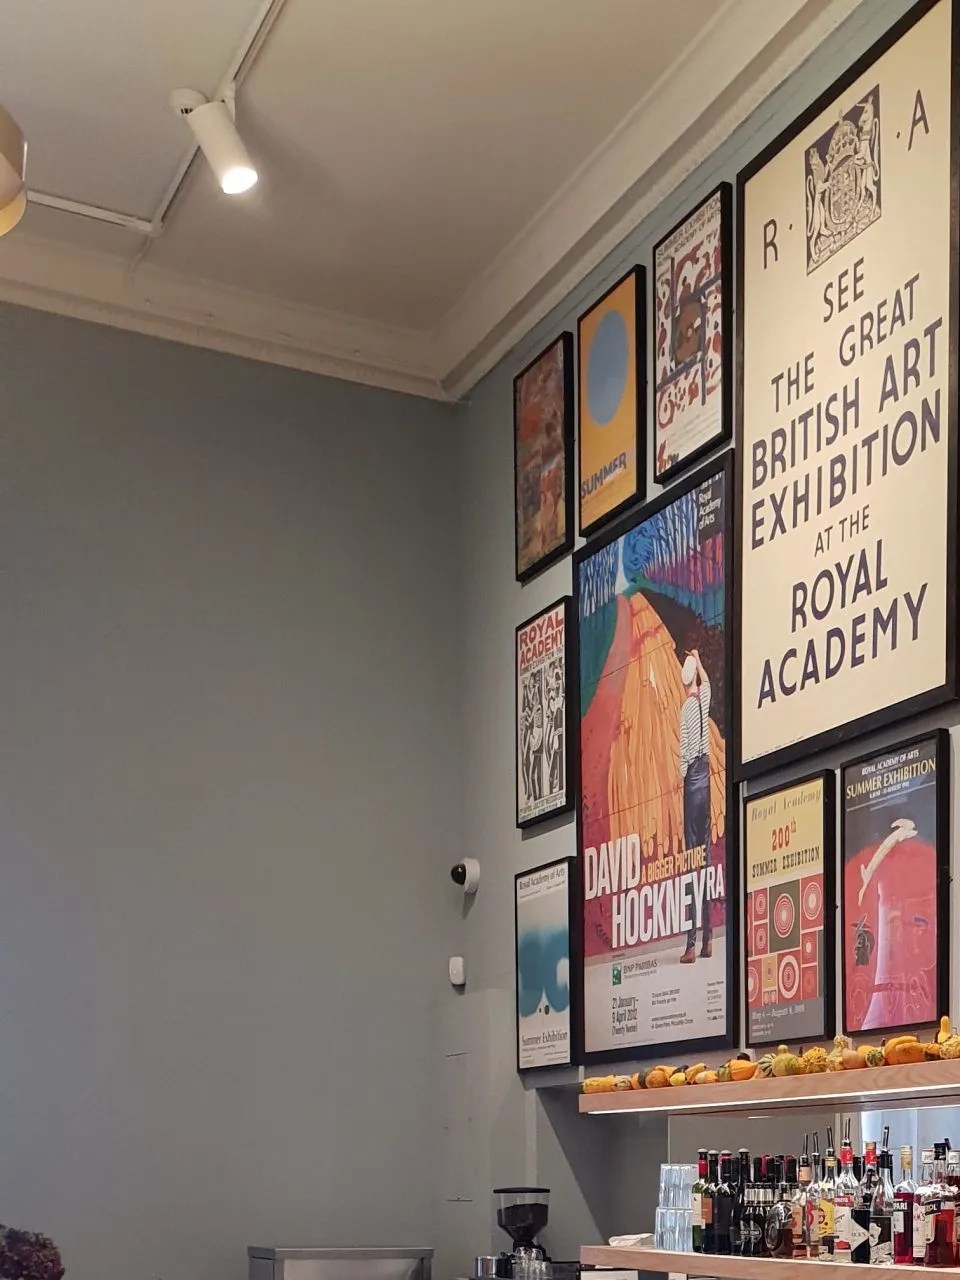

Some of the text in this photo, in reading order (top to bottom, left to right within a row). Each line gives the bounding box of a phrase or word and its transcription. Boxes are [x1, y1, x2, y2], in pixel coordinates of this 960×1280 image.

[823, 256, 866, 324] SEE
[771, 273, 921, 413] THE GREAT
[751, 316, 943, 490] BRITISH ART
[581, 452, 627, 500] SUMMER
[751, 388, 942, 551] EXHIBITION
[814, 504, 870, 558] AT THE
[791, 538, 889, 634] ROYAL
[519, 611, 564, 651] ROYAL
[519, 626, 564, 669] ACADEMY
[757, 582, 929, 710] ACADEMY
[846, 758, 937, 800] SUMMER EXHIBITION
[861, 749, 920, 776] ROYAL ACADEMY OF ARTS
[751, 789, 821, 822] Royal Academy
[772, 816, 797, 852] 200th
[584, 833, 641, 901] DAVID
[641, 844, 707, 885] A BIGGER PICTURE
[752, 846, 820, 879] SUMMER EXHIBITION
[612, 863, 725, 949] HOCKNEY RA
[635, 959, 658, 972] PARIBAS
[893, 1201, 908, 1211] PARI
